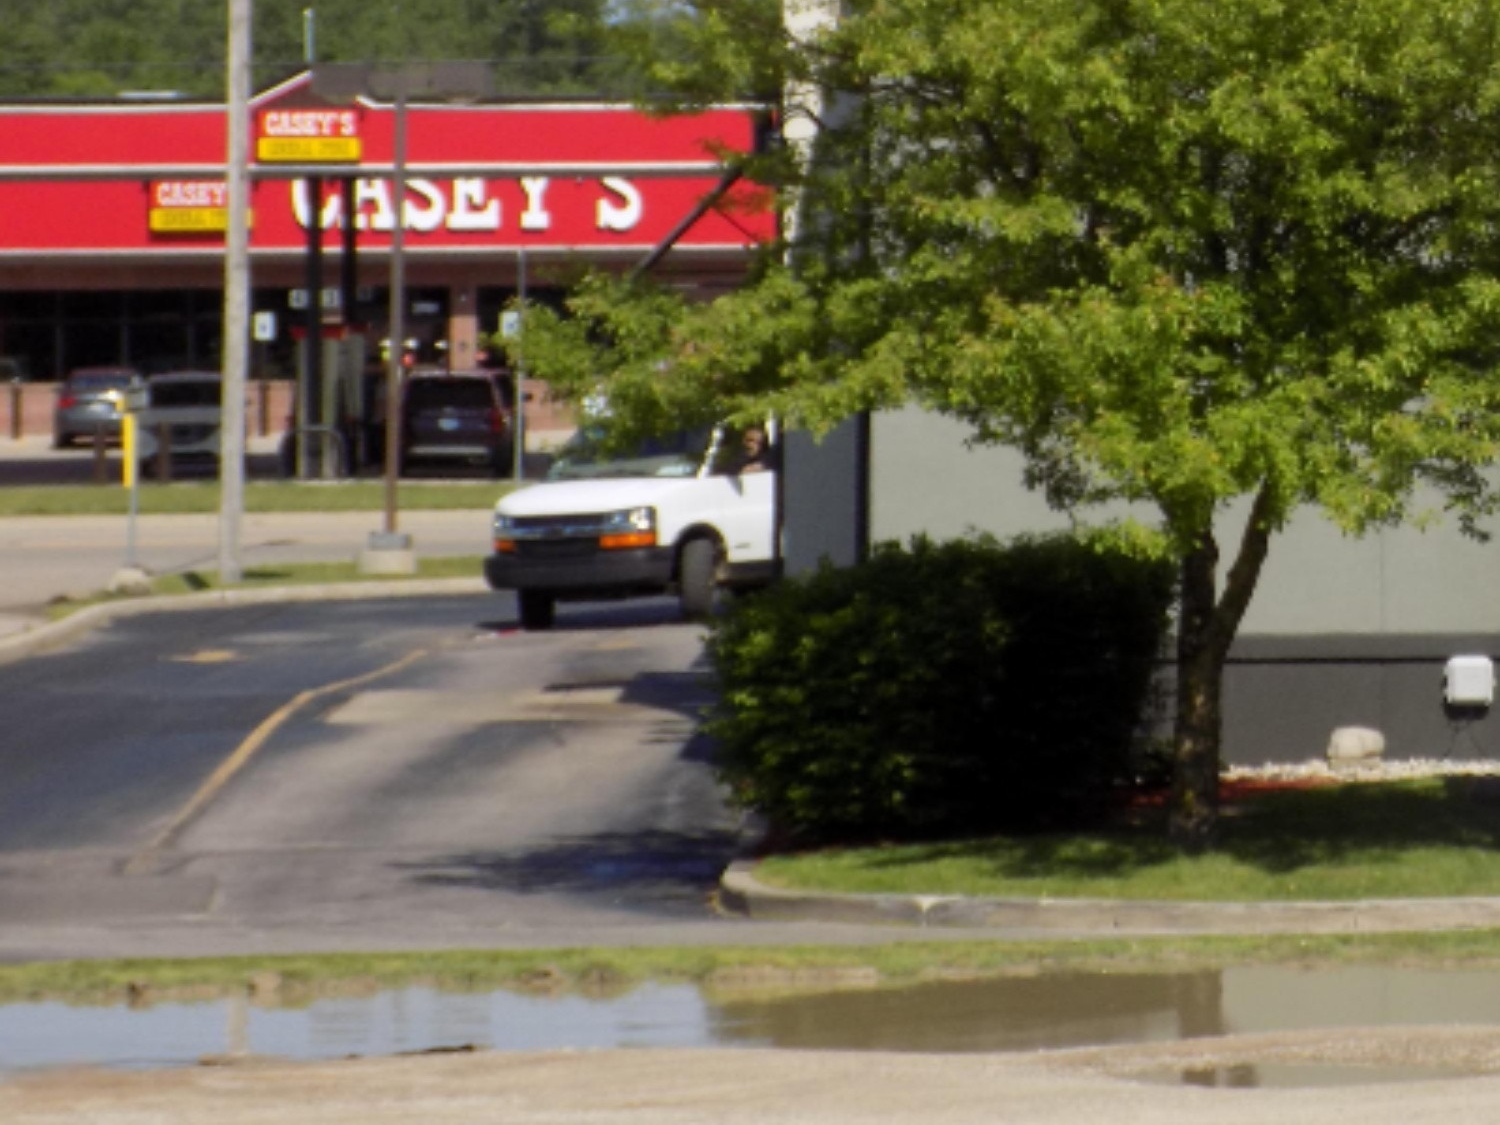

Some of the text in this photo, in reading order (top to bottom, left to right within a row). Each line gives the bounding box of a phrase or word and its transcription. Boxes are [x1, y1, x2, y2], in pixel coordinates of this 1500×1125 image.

[264, 111, 356, 136] CASEY'S
[156, 181, 228, 207] CASEY
[291, 176, 643, 231] ASEYS
